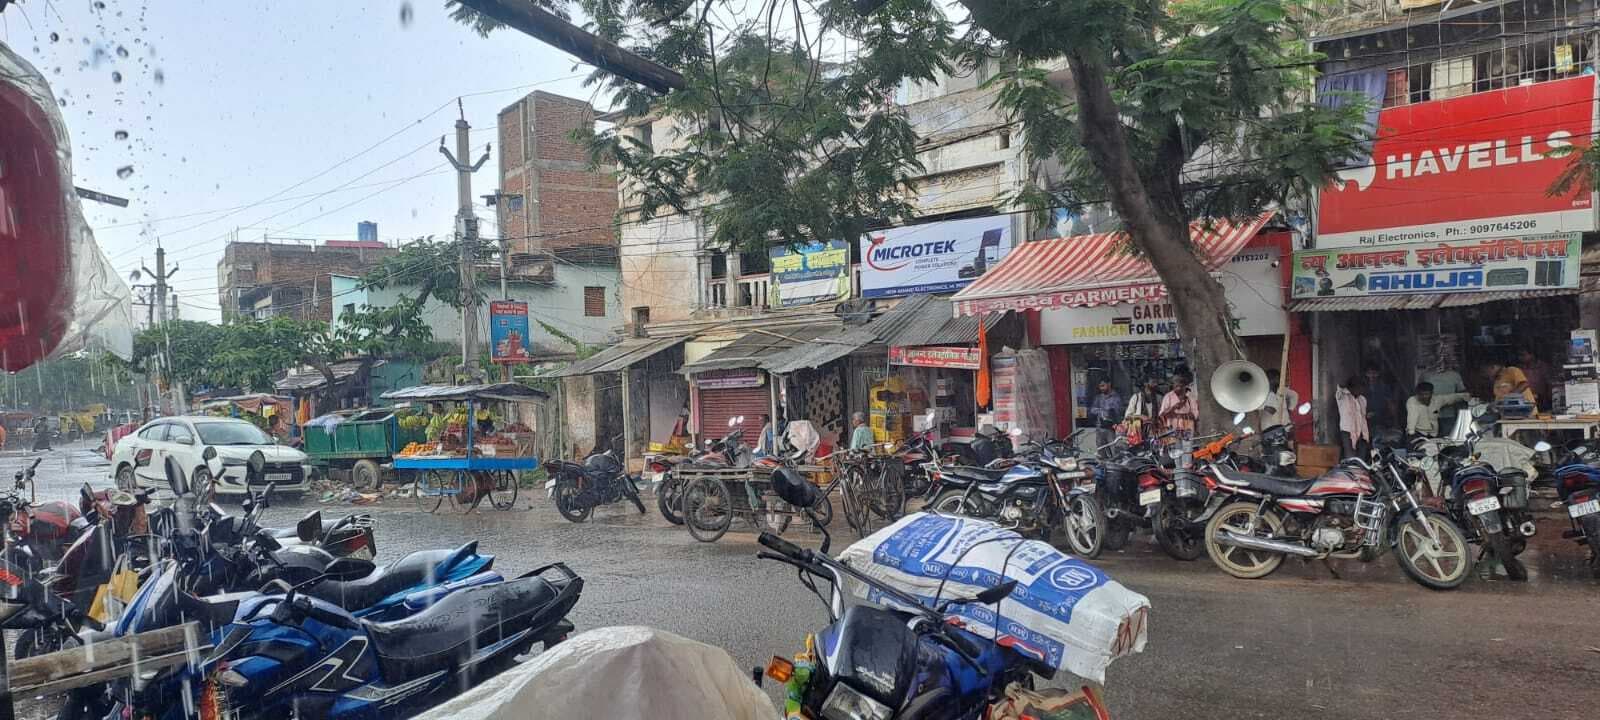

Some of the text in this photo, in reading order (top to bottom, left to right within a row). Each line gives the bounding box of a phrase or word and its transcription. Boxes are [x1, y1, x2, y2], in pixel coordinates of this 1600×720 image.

[1386, 131, 1572, 180] HAVELLS
[1360, 235, 1376, 246] Raj
[1470, 220, 1537, 235] 9097645206
[874, 240, 956, 261] MICROTEK
[1336, 250, 1409, 270] आनन्द
[1369, 270, 1483, 291] AHUJA
